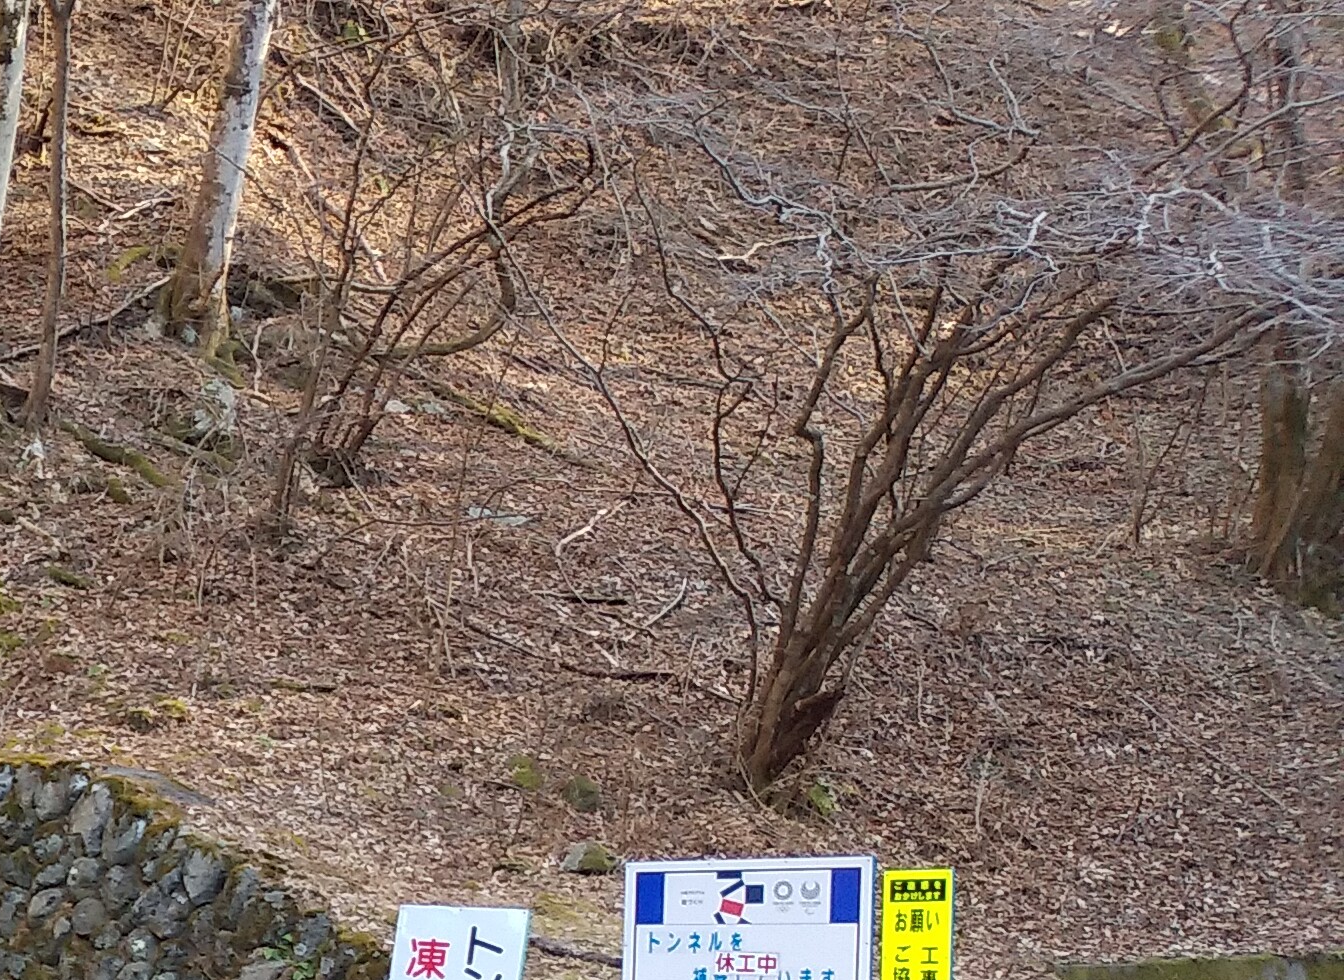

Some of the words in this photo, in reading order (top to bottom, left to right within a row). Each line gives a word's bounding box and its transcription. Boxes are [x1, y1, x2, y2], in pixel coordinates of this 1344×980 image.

[894, 909, 940, 933] お願い
[648, 931, 743, 953] トンネルを
[715, 953, 777, 974] 休工中
